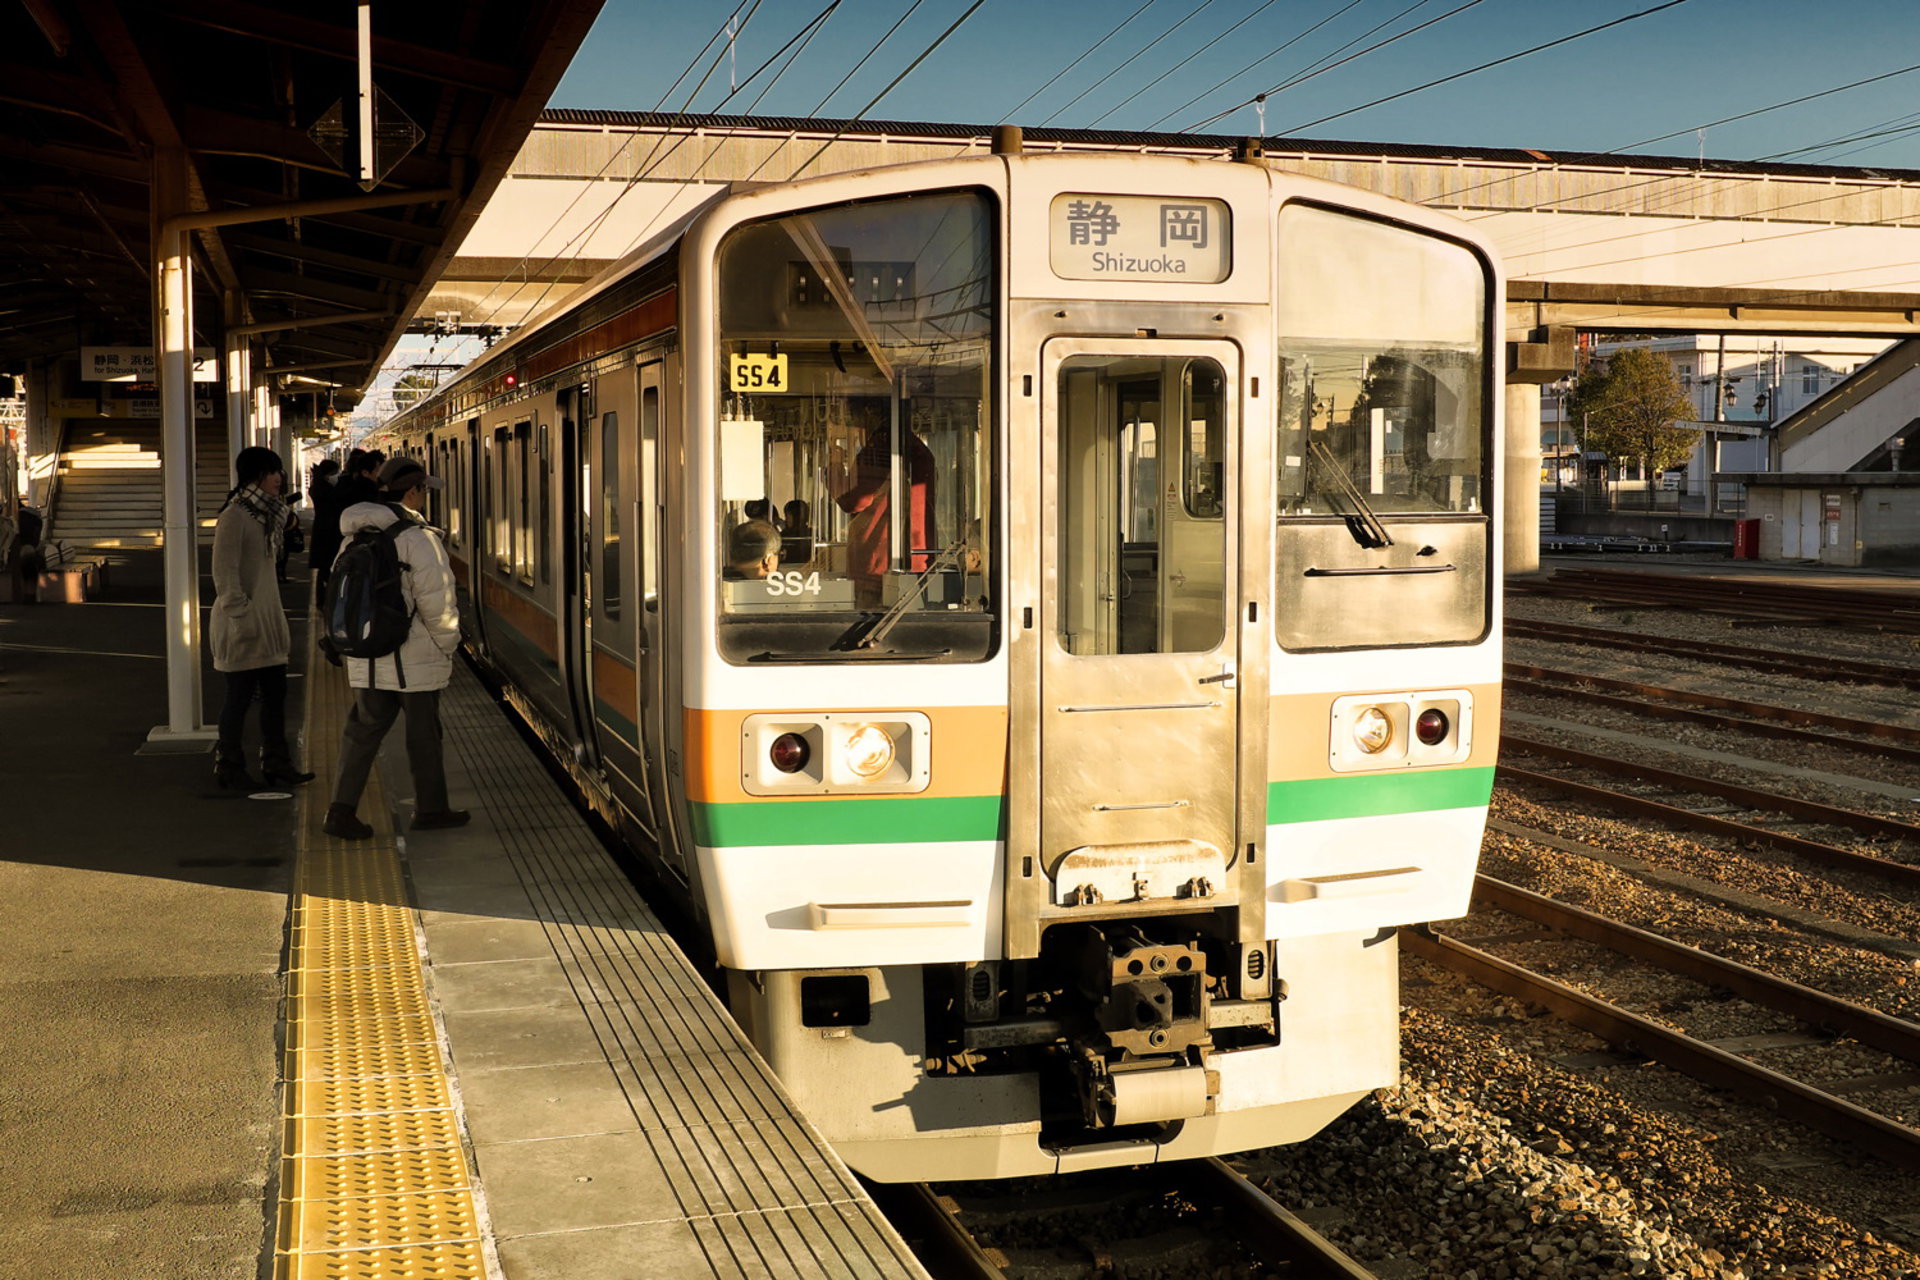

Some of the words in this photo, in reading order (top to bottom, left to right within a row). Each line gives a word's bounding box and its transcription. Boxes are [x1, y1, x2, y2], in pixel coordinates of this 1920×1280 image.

[1067, 199, 1208, 249] 静岡
[1092, 251, 1186, 273] Shizuoka
[193, 357, 204, 371] 2
[737, 364, 781, 387] SS4
[766, 571, 822, 596] SS4
